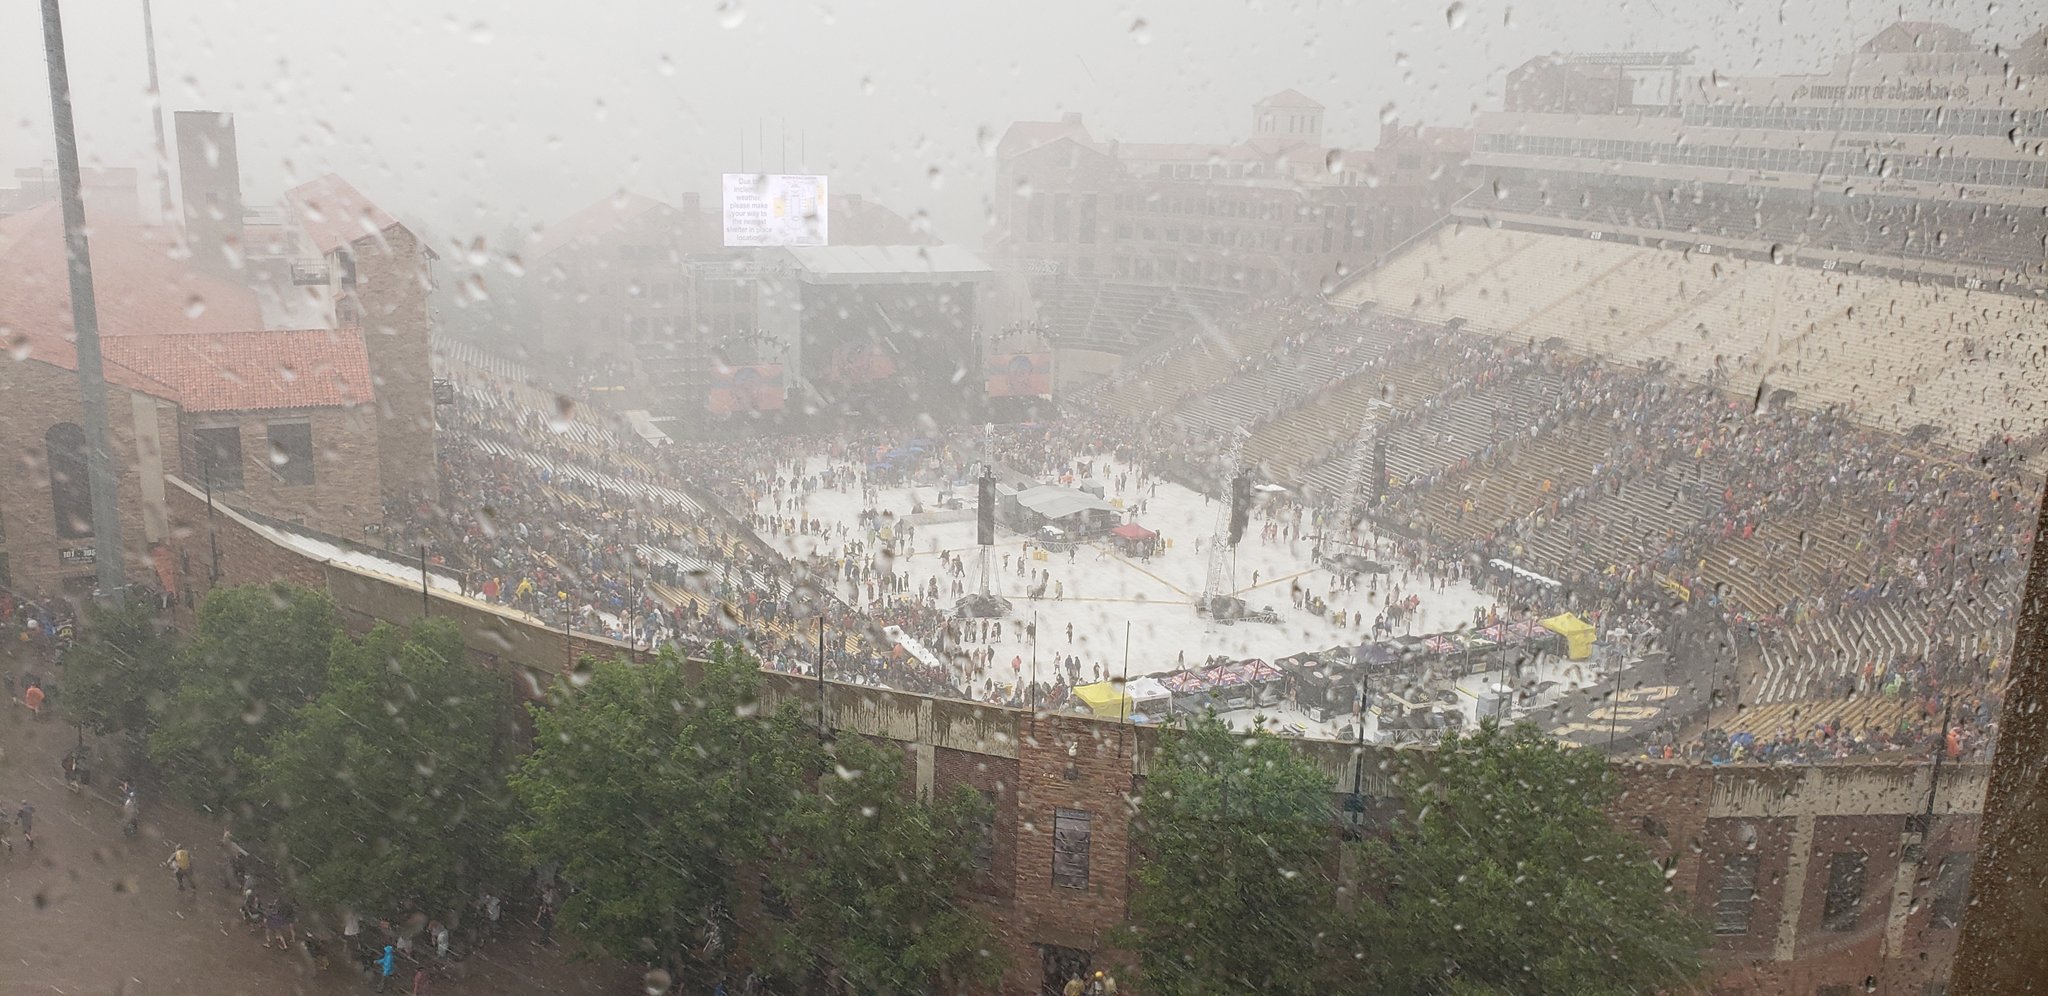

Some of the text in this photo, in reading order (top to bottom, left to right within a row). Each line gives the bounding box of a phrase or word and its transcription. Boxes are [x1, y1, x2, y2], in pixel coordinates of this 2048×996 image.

[1810, 85, 1948, 100] UNIVERSITY OF COLORADO
[738, 177, 751, 185] Due
